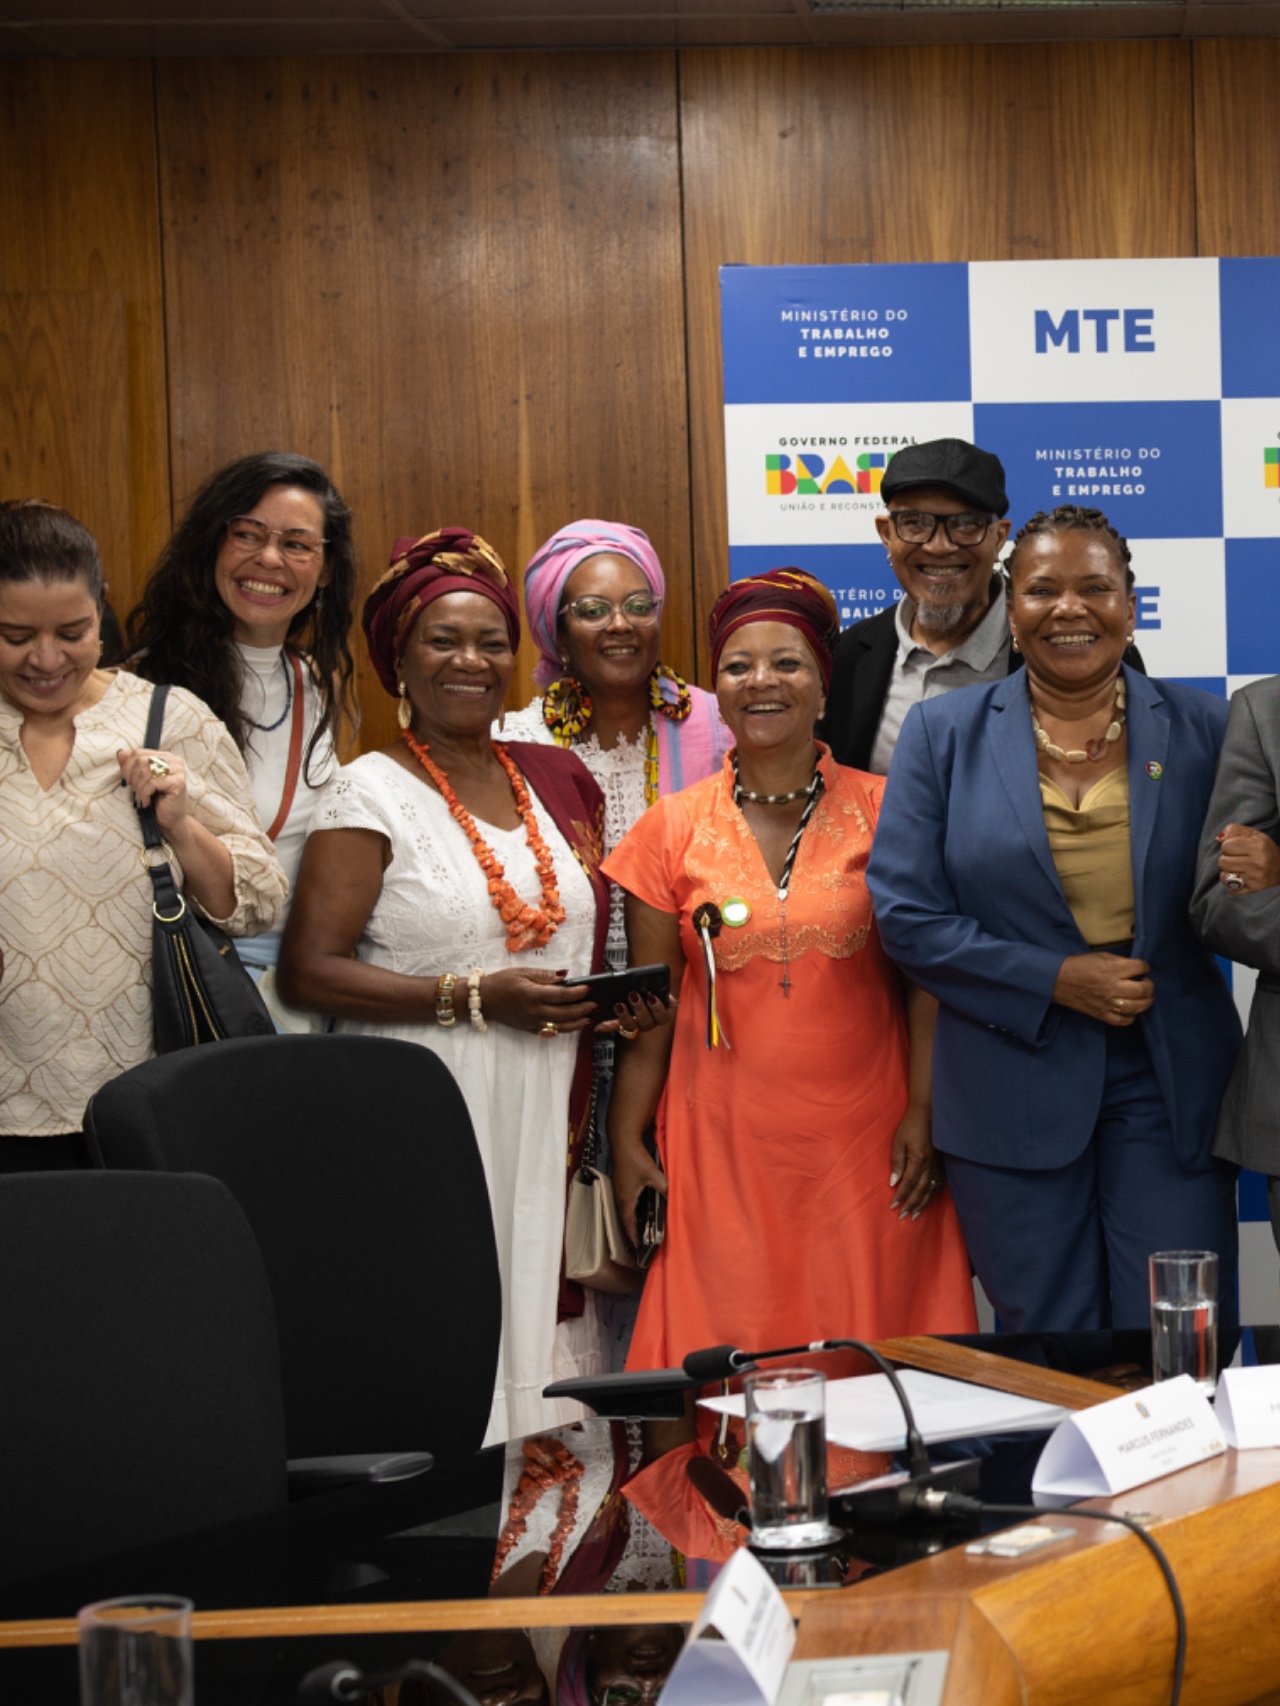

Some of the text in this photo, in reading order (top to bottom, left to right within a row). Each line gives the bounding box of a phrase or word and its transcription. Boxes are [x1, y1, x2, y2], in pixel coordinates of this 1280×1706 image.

[781, 307, 908, 321] MINISTÉRIO DO
[800, 328, 889, 340] TRABALHO
[1034, 308, 1155, 354] MTE
[798, 346, 893, 358] E EMPREGO
[779, 436, 918, 447] GOVERNO FEDERAL
[1035, 446, 1160, 460] MINISTÉRIO DO
[765, 453, 894, 495] BRAS
[1054, 466, 1142, 478] TRABALHO
[1052, 484, 1146, 496] E EMPREGO
[780, 501, 815, 511] UNIÃO
[830, 502, 886, 511] RECONST
[830, 587, 886, 601] STÉRIO
[841, 607, 884, 619] BALH
